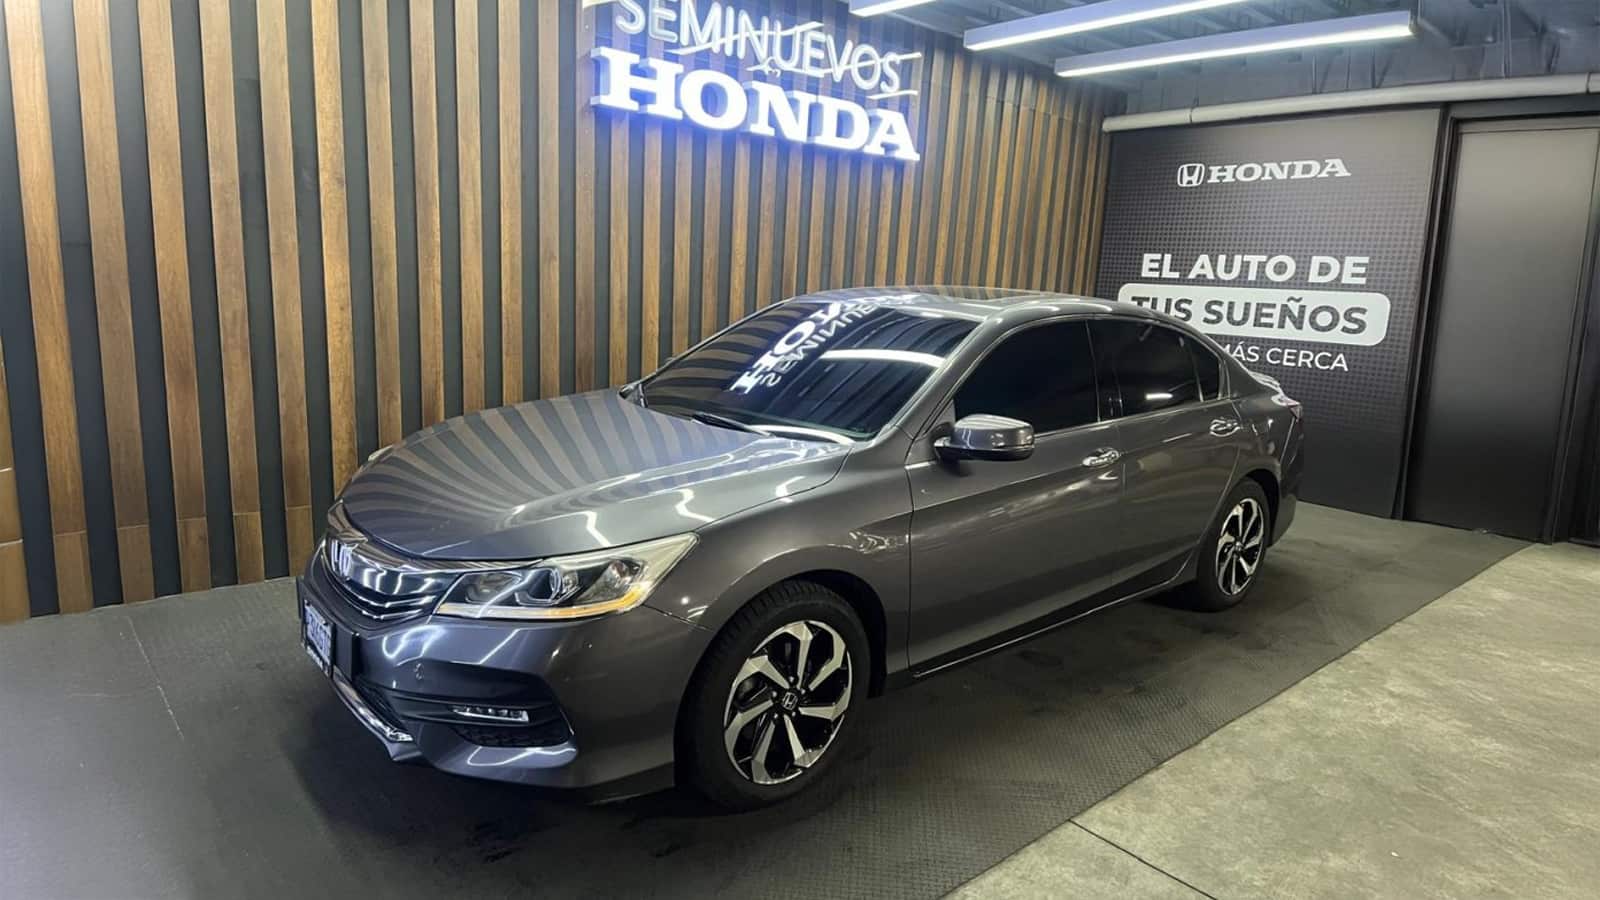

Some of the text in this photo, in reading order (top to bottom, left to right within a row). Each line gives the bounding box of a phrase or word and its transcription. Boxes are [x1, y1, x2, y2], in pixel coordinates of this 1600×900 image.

[616, 0, 901, 93] SEMINUEVOS
[591, 46, 920, 161] HONDA
[1207, 158, 1351, 183] HONDA
[1141, 253, 1370, 285] EL AUTO DE
[1203, 296, 1368, 335] SUEÑOS
[1223, 341, 1348, 371] ÁS CERCA
